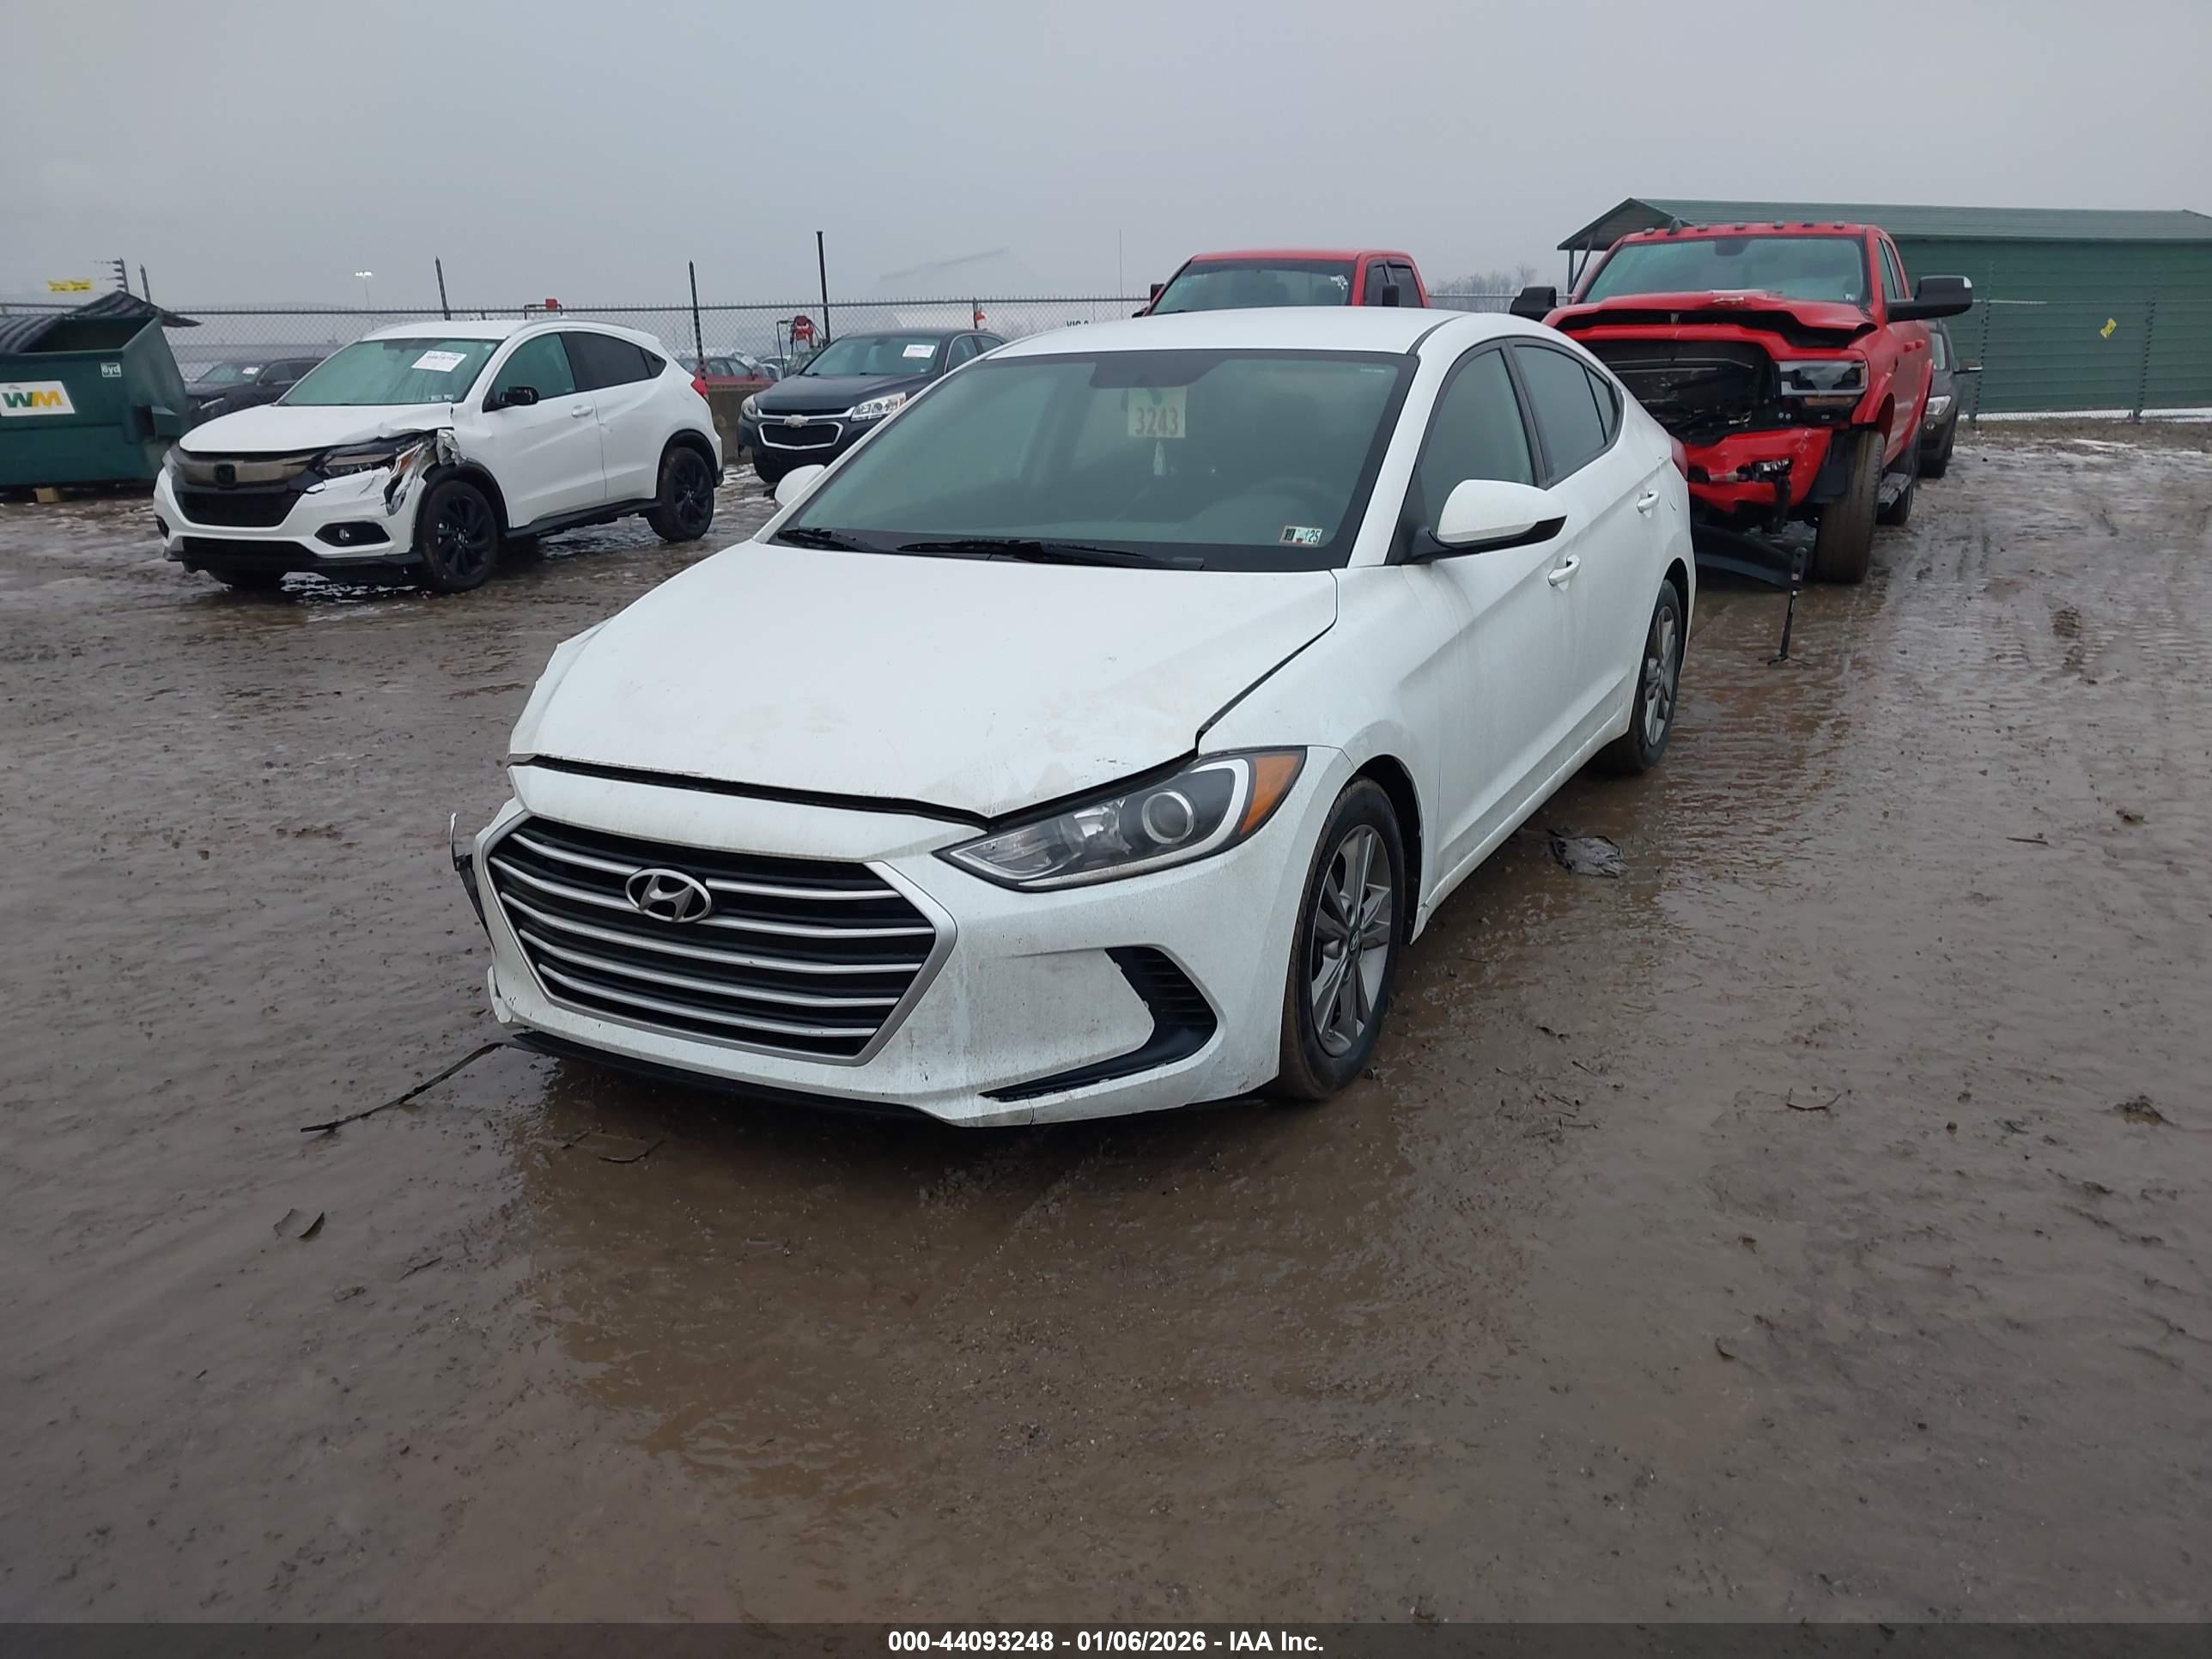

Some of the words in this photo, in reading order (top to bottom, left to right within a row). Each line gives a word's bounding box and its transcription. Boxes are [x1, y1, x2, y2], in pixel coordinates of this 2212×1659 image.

[1, 390, 63, 409] WM
[1134, 406, 1179, 435] 3243
[1308, 529, 1321, 544] 25
